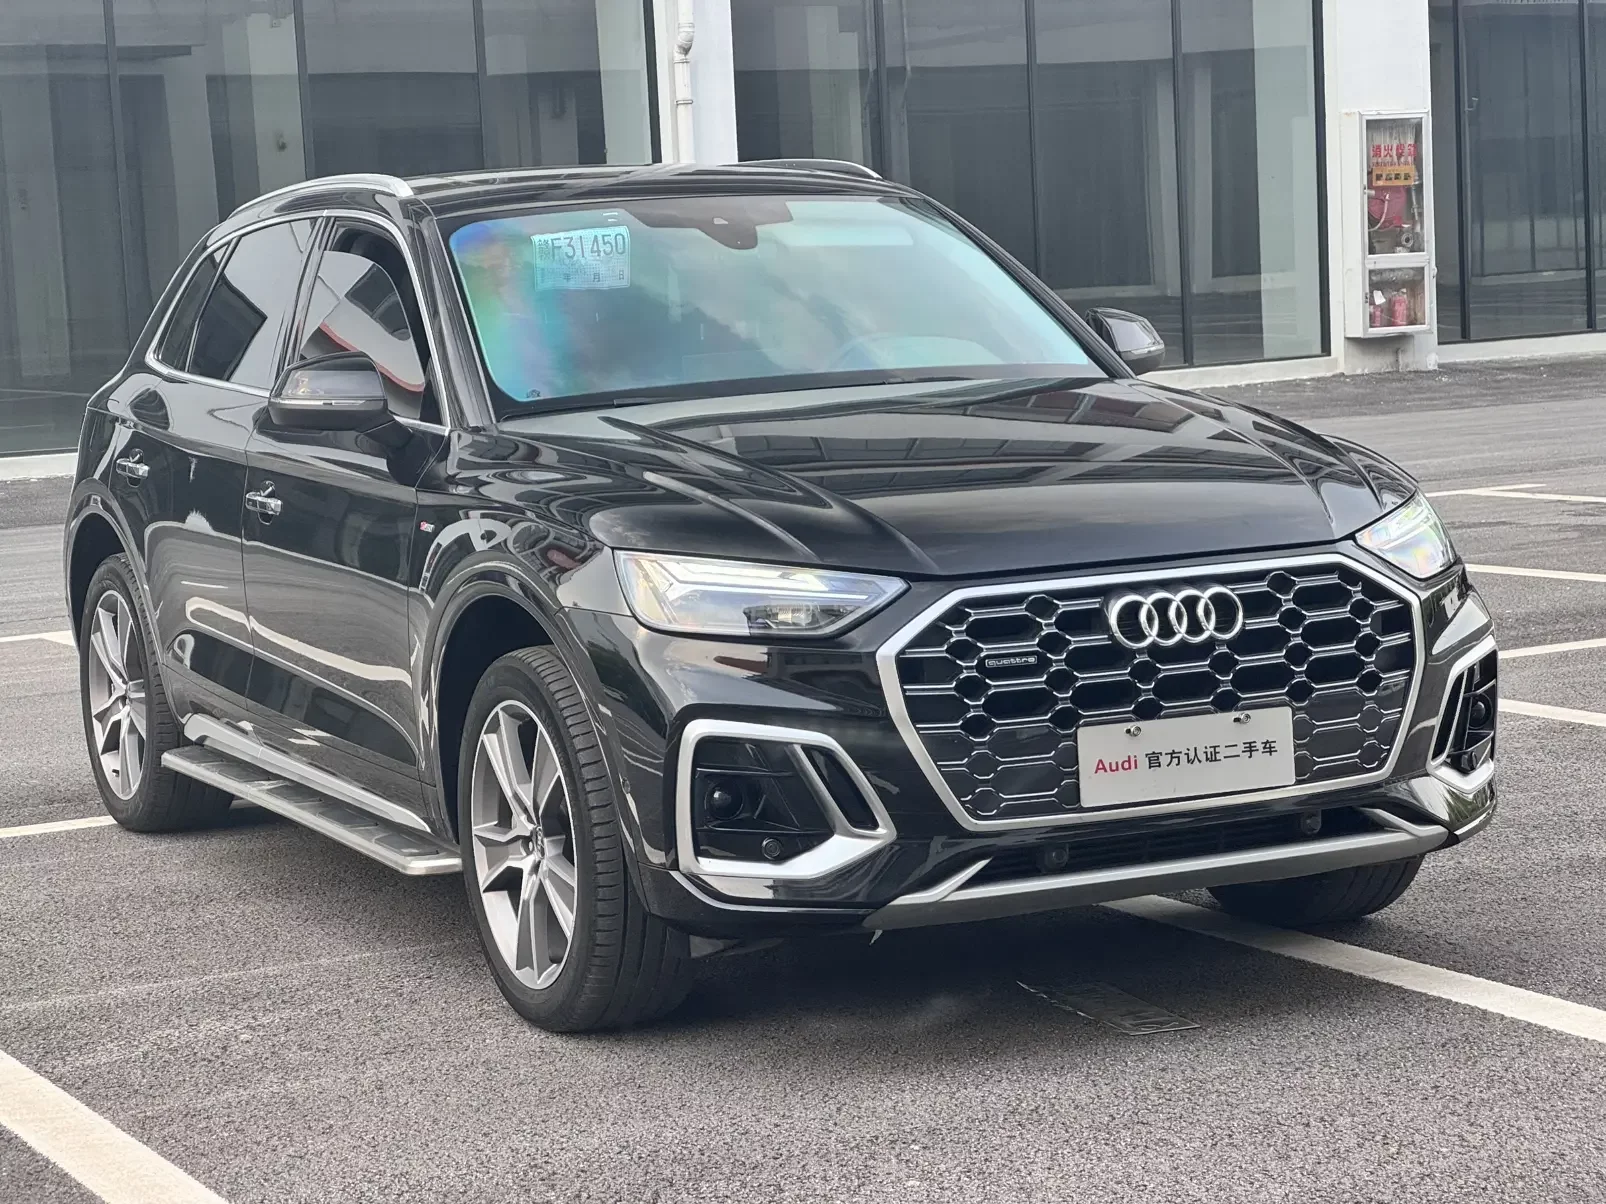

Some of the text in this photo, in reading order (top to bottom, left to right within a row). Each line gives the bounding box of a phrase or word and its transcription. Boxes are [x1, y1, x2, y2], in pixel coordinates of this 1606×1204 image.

[988, 657, 1036, 666] quattro
[1094, 739, 1278, 774] Audi 官方认证二手车
